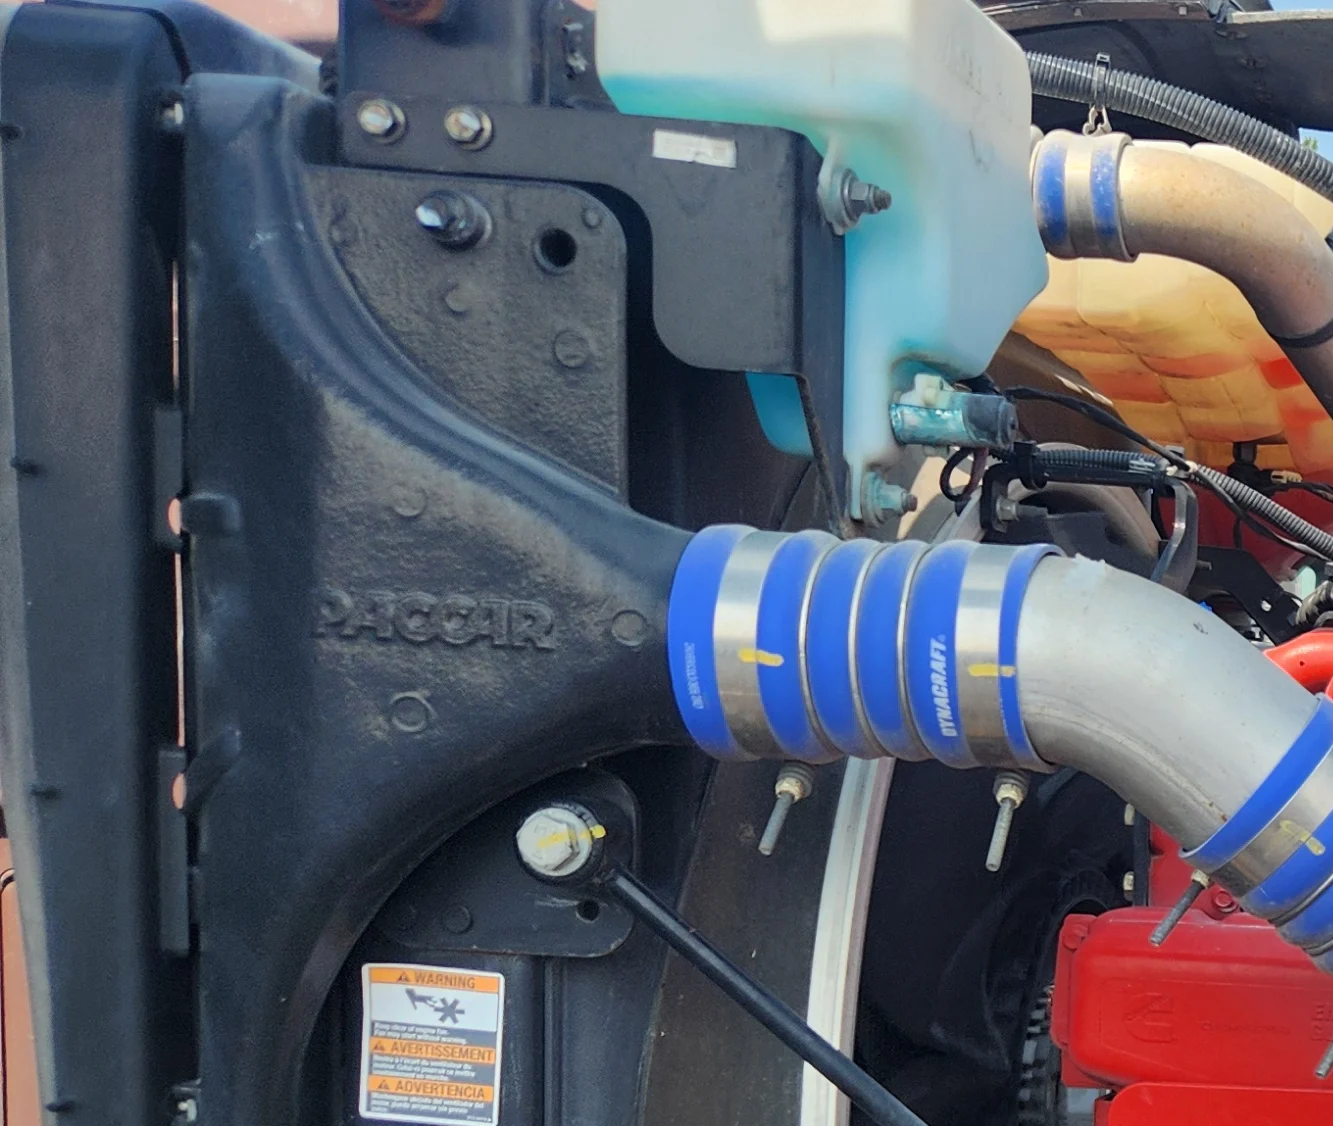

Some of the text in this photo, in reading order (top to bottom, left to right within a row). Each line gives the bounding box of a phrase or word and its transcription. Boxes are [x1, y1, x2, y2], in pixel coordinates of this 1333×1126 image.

[311, 587, 556, 652] PACCAR
[930, 638, 958, 737] DYNACRAFT
[414, 971, 475, 989] WARNING
[391, 1042, 494, 1061] AVERTISSEMENT
[395, 1079, 485, 1099] ADVERTENCIA
